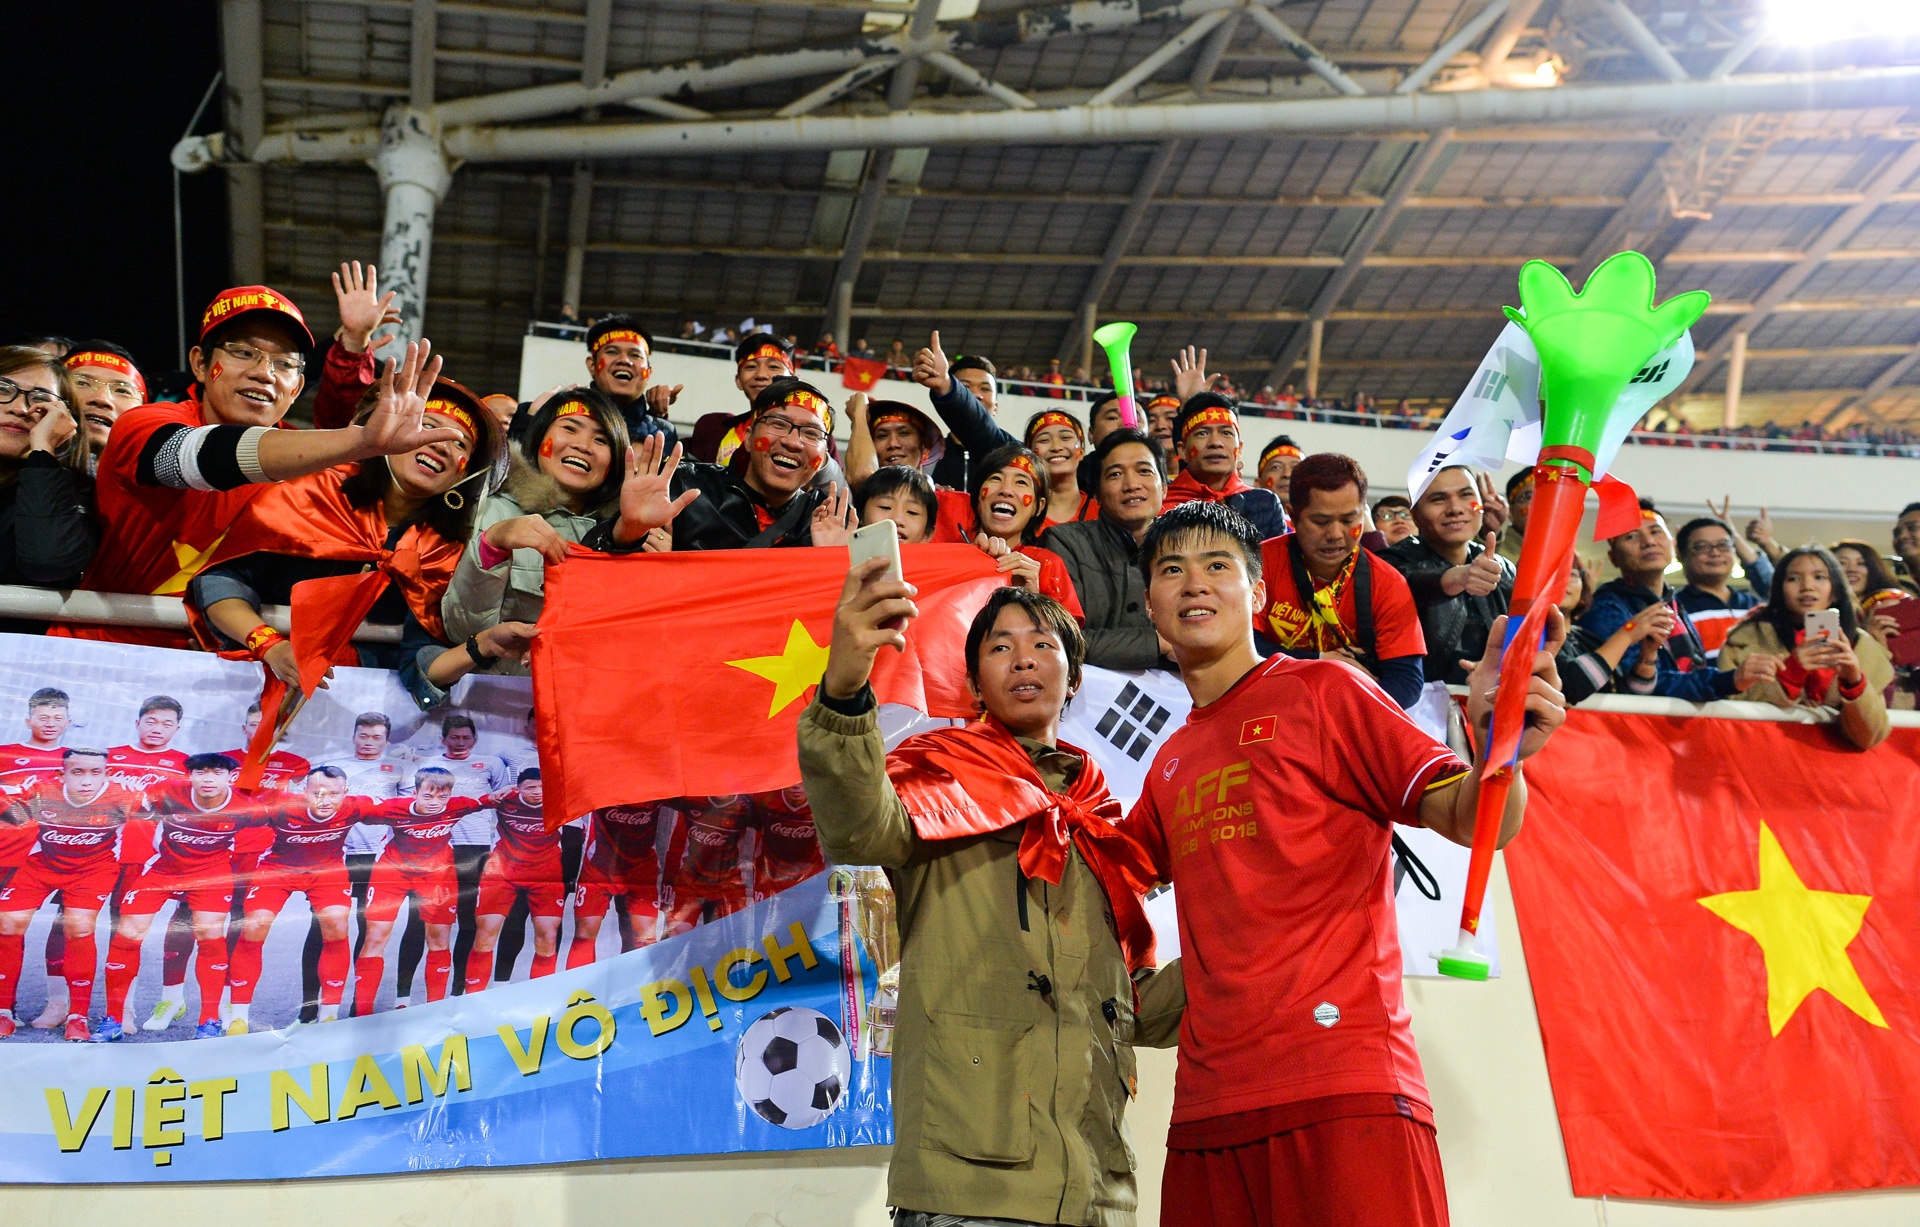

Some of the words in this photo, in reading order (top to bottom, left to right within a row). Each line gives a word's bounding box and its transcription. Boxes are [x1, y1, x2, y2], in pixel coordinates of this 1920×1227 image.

[212, 298, 231, 315] VIỆT
[233, 294, 258, 308] NAM
[94, 353, 120, 366] ĐỊCH
[1188, 411, 1207, 430] NAM
[1271, 601, 1293, 619] VIỆT
[1172, 760, 1251, 829] AFF
[1211, 821, 1257, 843] 2018
[44, 1067, 237, 1167] VIỆT
[269, 1034, 472, 1133] NAM
[496, 989, 617, 1077] VÔ
[639, 921, 819, 1037] ĐỊCH
